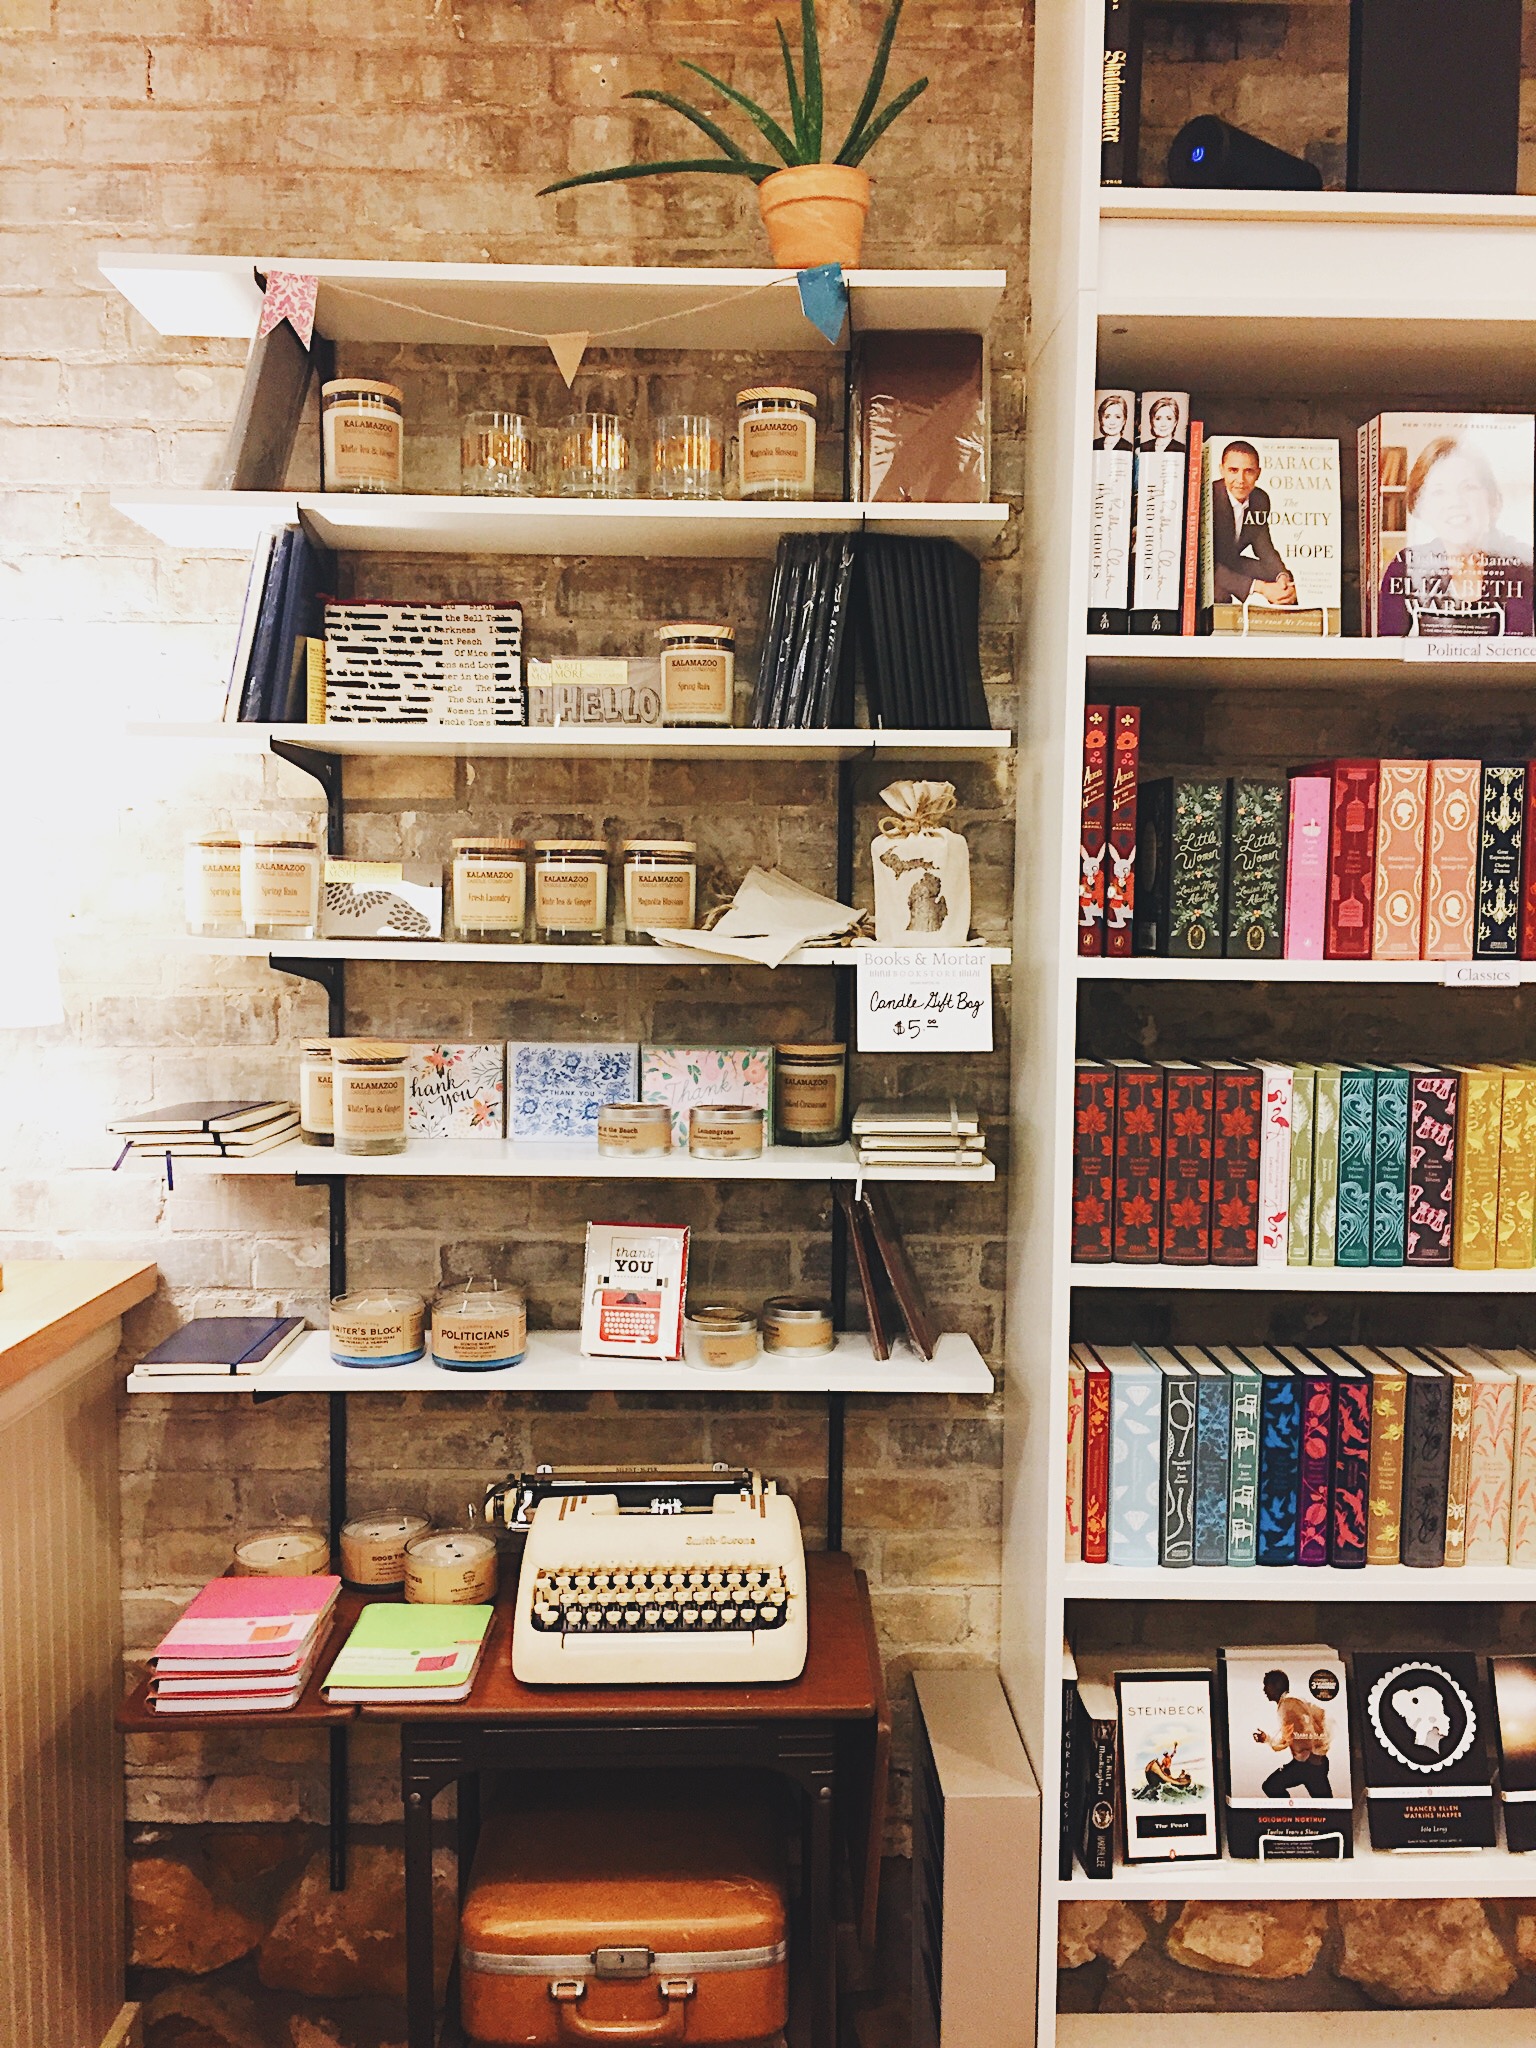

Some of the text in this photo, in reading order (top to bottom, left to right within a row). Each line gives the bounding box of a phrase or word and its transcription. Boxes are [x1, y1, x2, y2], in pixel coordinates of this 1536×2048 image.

[1102, 50, 1127, 143] Shadowmancer
[344, 420, 393, 432] KALAMAZOO
[750, 423, 798, 433] KALAMAZOO
[1263, 456, 1333, 471] BARACK
[1269, 476, 1332, 490] OBAMA
[1283, 499, 1299, 508] The
[1243, 511, 1332, 526] AUDACITY
[1092, 483, 1106, 579] HARD CHOICES
[1144, 485, 1156, 580] HARD CHOICES
[1188, 515, 1197, 548] BERNIE
[1293, 530, 1303, 542] of
[1286, 545, 1334, 559] HOPE
[1468, 551, 1520, 567] Chance
[1186, 550, 1195, 589] SANDERS
[1389, 577, 1523, 598] ELIZABETH
[1405, 599, 1507, 618] WARREN
[463, 614, 483, 622] Bell
[454, 649, 488, 657] Of Mice
[1427, 643, 1536, 657] Political Science
[555, 670, 583, 678] MORE
[448, 695, 464, 703] The
[558, 687, 661, 724] HELLO
[468, 718, 491, 726] Tom's
[1180, 832, 1217, 852] Little
[1239, 833, 1277, 853] Little
[1174, 849, 1220, 870] Women
[1234, 849, 1279, 870] Women
[203, 864, 240, 872] KALAMAZ
[255, 863, 306, 872] KALAMAZOO
[466, 871, 514, 879] KALAMAZOO
[261, 886, 282, 897] Spring
[1200, 880, 1218, 894] May
[1260, 881, 1278, 895] May
[486, 893, 511, 904] Laundry
[864, 952, 986, 966] Books & Mortar
[1457, 968, 1511, 982] Classics
[870, 991, 984, 1018] Candle Gift Bag
[350, 1081, 398, 1089] KALAMAZOO
[410, 1069, 470, 1099] hank
[664, 1070, 732, 1105] Thank
[785, 1078, 828, 1086] KALAMAZOO
[429, 1086, 484, 1115] you
[364, 1104, 375, 1113] Tea
[697, 1127, 734, 1136] Lemongrass
[616, 1247, 655, 1259] thank
[615, 1259, 654, 1274] YOU
[370, 1326, 402, 1336] BLOCK
[441, 1329, 510, 1341] POLITICIANS
[685, 1536, 756, 1546] Smith-Corona
[1128, 1705, 1205, 1717] STEINBECK
[1106, 1753, 1113, 1763] To
[1095, 1745, 1106, 1795] Mockingbird
[1096, 1856, 1106, 1868] LEE
